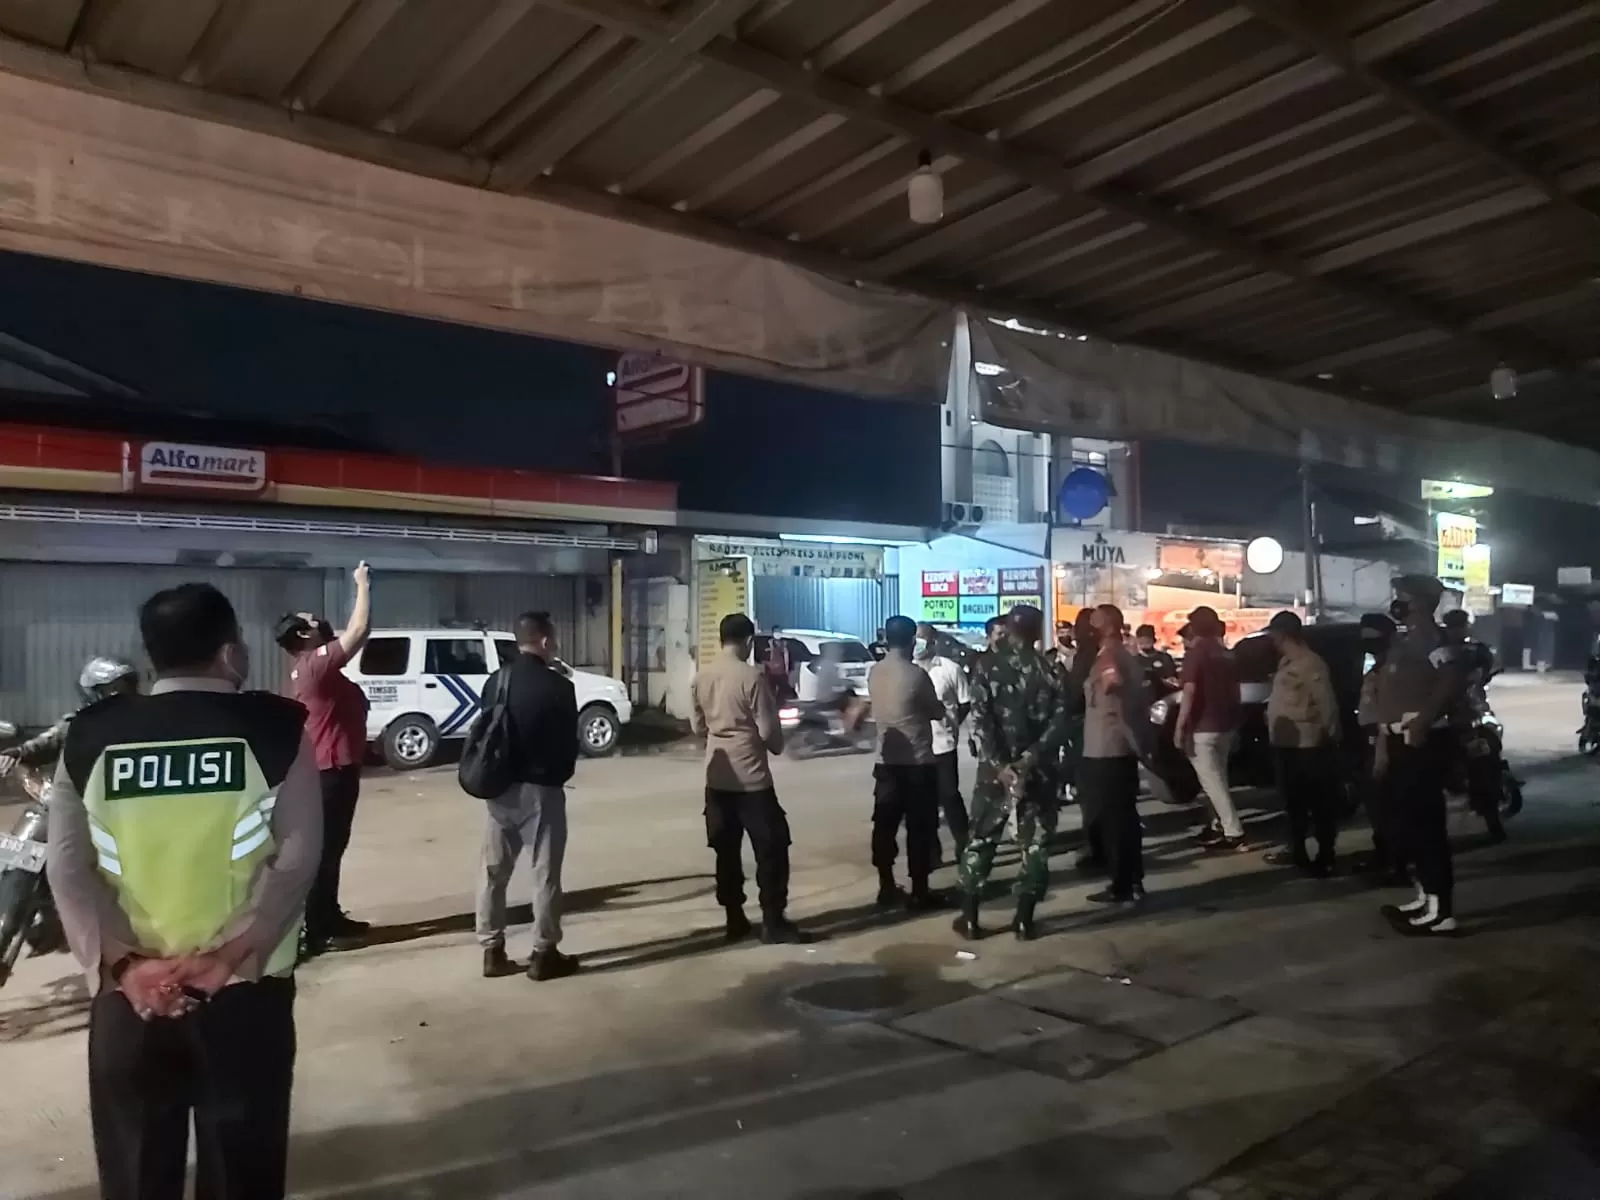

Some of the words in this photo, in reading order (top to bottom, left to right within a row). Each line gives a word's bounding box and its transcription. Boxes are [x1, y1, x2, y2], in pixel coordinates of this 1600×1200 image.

[150, 448, 257, 473] Alfamart
[1082, 543, 1125, 563] MUYA
[924, 599, 955, 610] POTATO
[112, 751, 232, 791] POLISI
